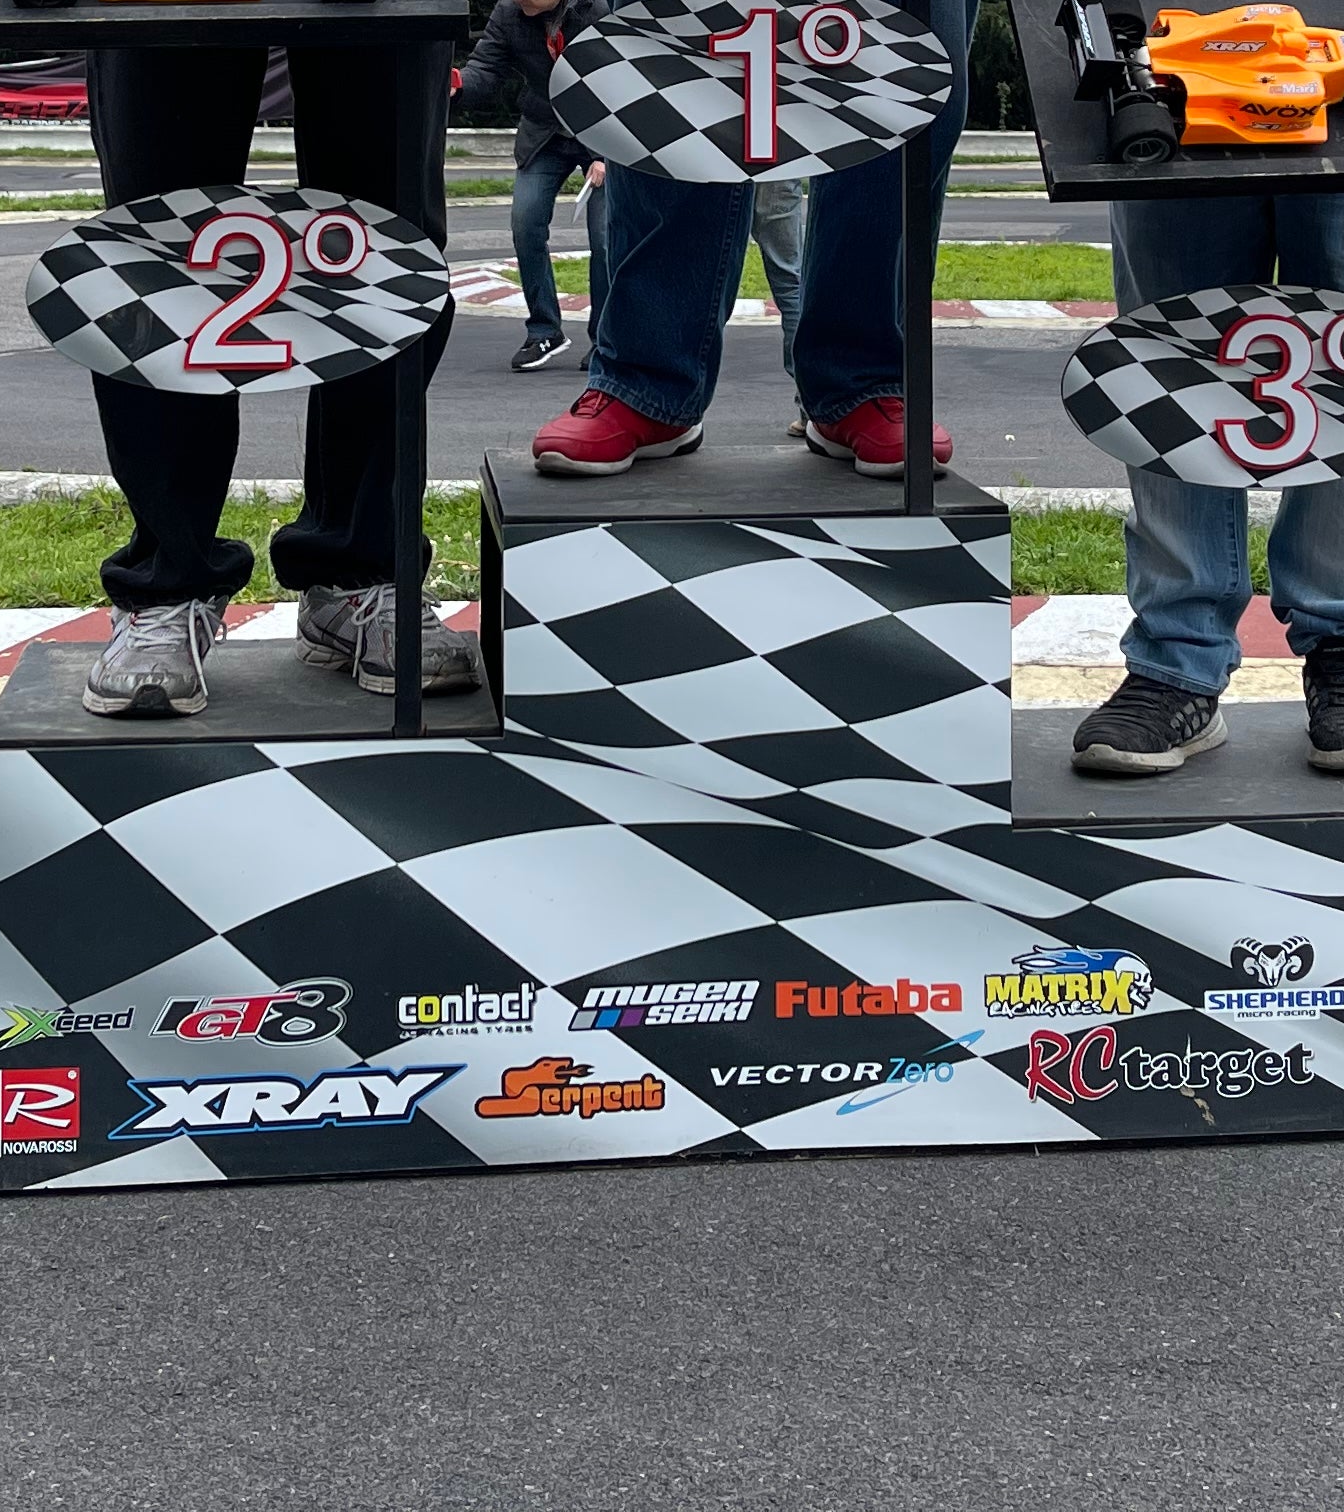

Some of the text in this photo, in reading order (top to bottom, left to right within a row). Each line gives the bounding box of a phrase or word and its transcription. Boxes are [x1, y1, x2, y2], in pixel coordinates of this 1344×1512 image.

[1201, 41, 1266, 52] XRAY
[398, 982, 534, 1025] contact
[774, 978, 963, 1018] Futaba
[986, 969, 1135, 1014] MATRIX
[1276, 1009, 1317, 1018] racing
[710, 1057, 954, 1086] VECTOR Zero
[131, 1070, 444, 1131] XRAY
[3, 1139, 77, 1155] NOVAROSSI
